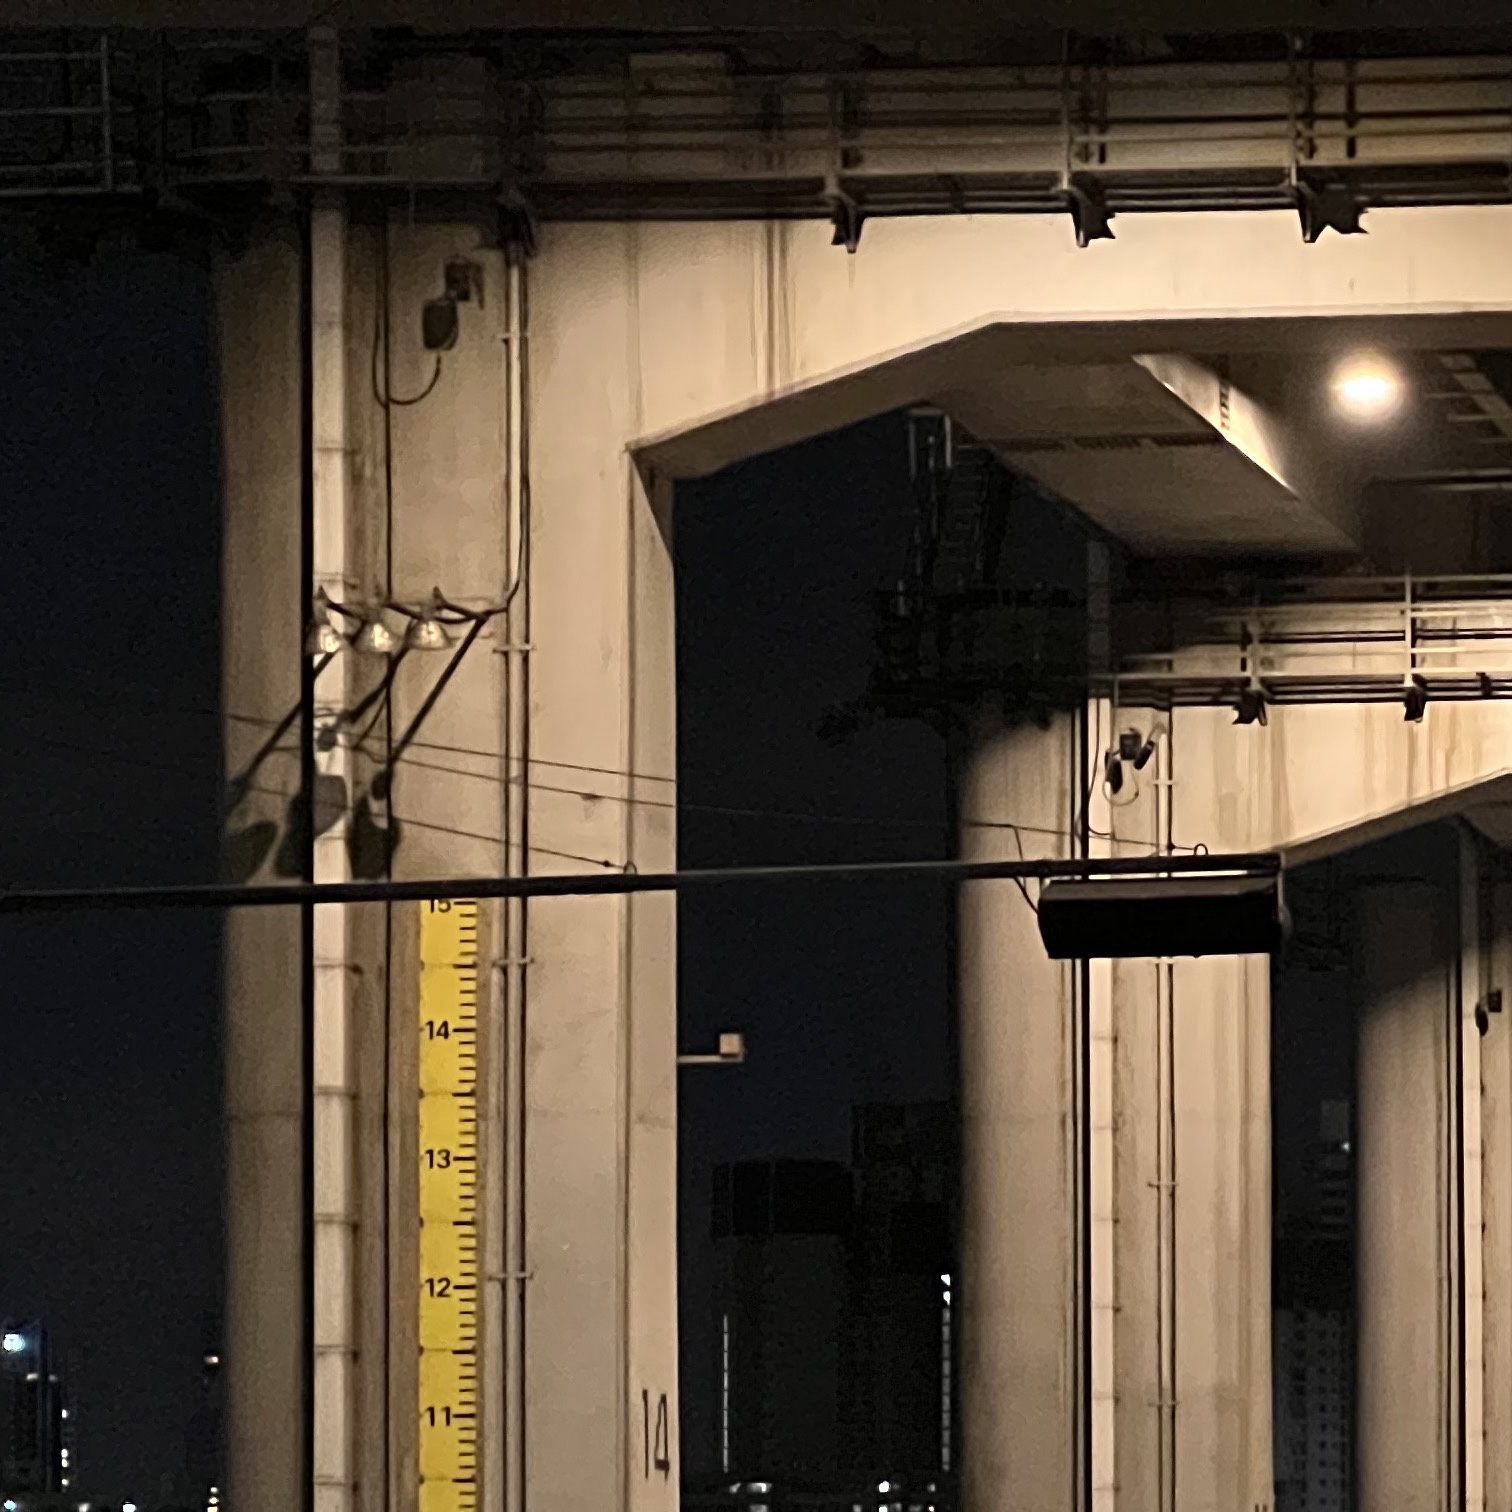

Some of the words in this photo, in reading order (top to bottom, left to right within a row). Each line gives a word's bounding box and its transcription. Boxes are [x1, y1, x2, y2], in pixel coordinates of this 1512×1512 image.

[429, 899, 452, 914] 15
[425, 1020, 450, 1040] 14
[425, 1148, 451, 1169] 13
[425, 1277, 451, 1298] 12
[426, 1405, 451, 1427] 11
[642, 1389, 671, 1482] 14
